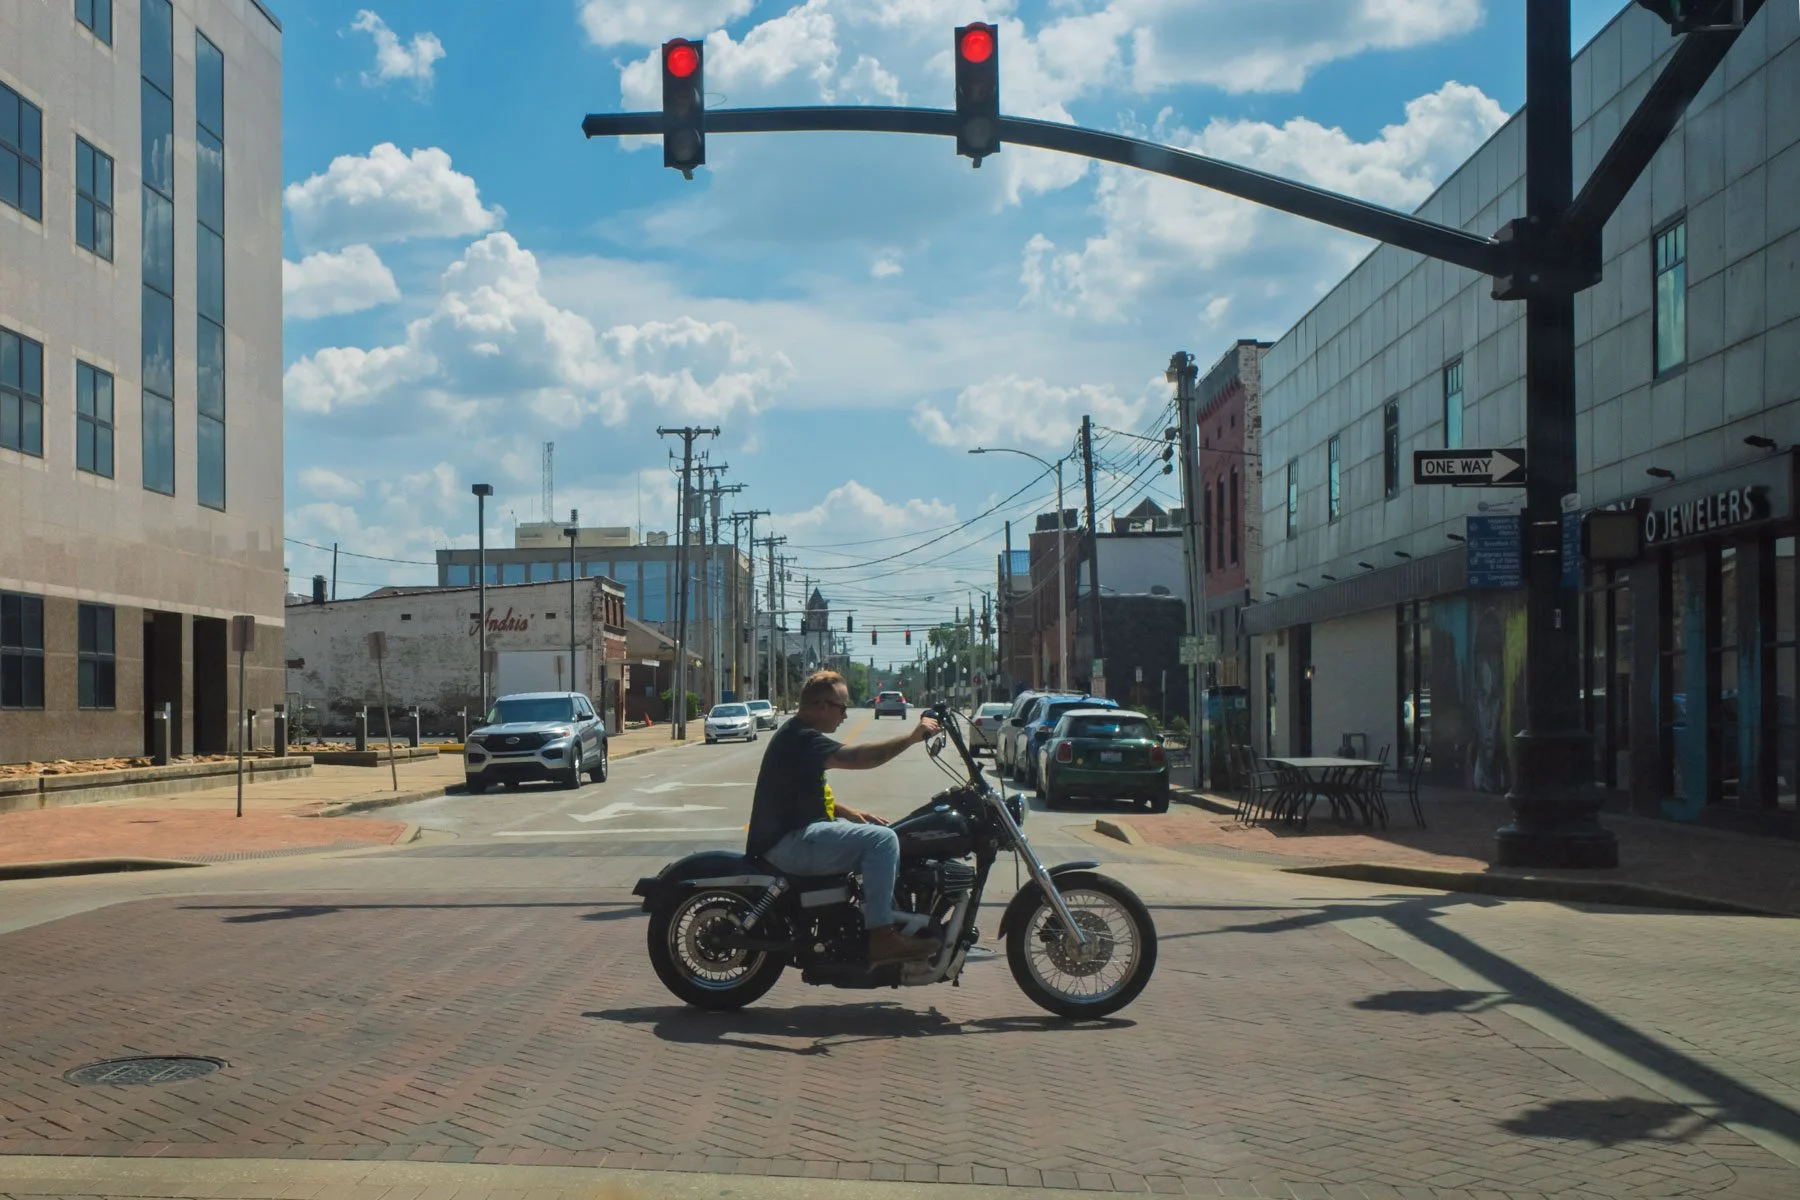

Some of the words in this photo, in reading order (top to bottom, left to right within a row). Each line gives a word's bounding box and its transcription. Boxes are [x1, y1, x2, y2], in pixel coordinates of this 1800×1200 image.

[1426, 460, 1455, 475] ONE
[1461, 459, 1492, 473] WAY
[1662, 485, 1753, 540] JEWELERS
